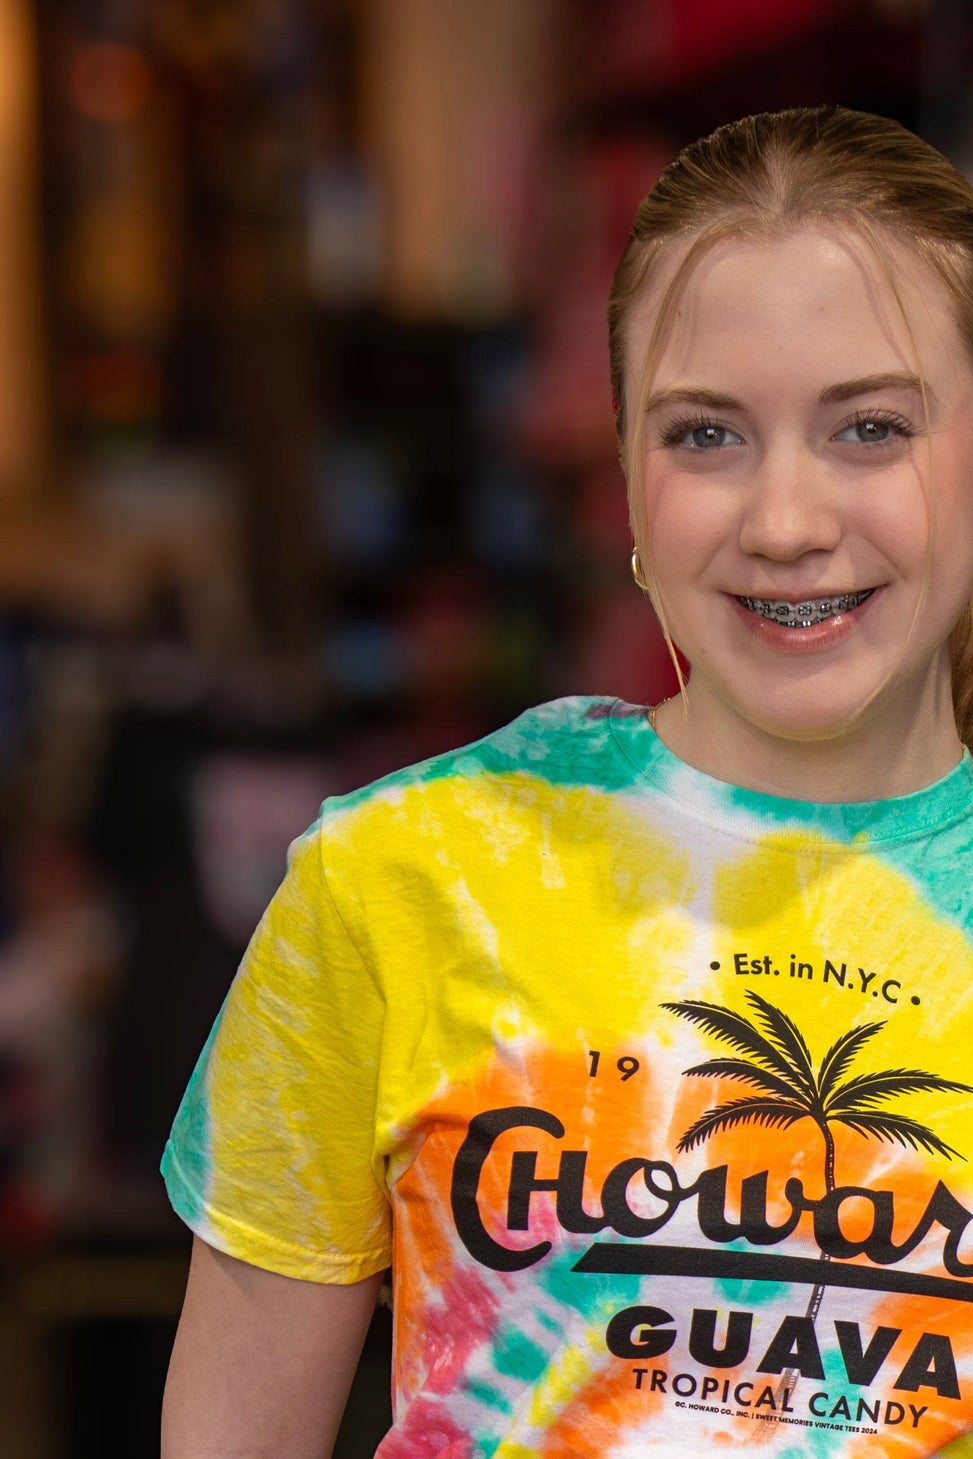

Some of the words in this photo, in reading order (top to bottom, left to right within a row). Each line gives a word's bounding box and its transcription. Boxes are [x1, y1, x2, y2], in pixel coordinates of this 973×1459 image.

[733, 952, 780, 977] Est.
[788, 956, 812, 980] in
[822, 960, 902, 1005] N.Y.C
[586, 1050, 641, 1082] 19
[605, 1304, 963, 1401] GUAVA
[632, 1367, 796, 1413] TROPICAL
[808, 1390, 929, 1430] CANDY
[688, 1403, 720, 1415] HOWARD
[736, 1411, 751, 1419] INC.
[755, 1414, 779, 1424] SWEET
[779, 1416, 814, 1428] MEMORIES
[814, 1421, 844, 1431] VINTAGE
[845, 1425, 860, 1434] TEES
[861, 1427, 878, 1435] 2024
